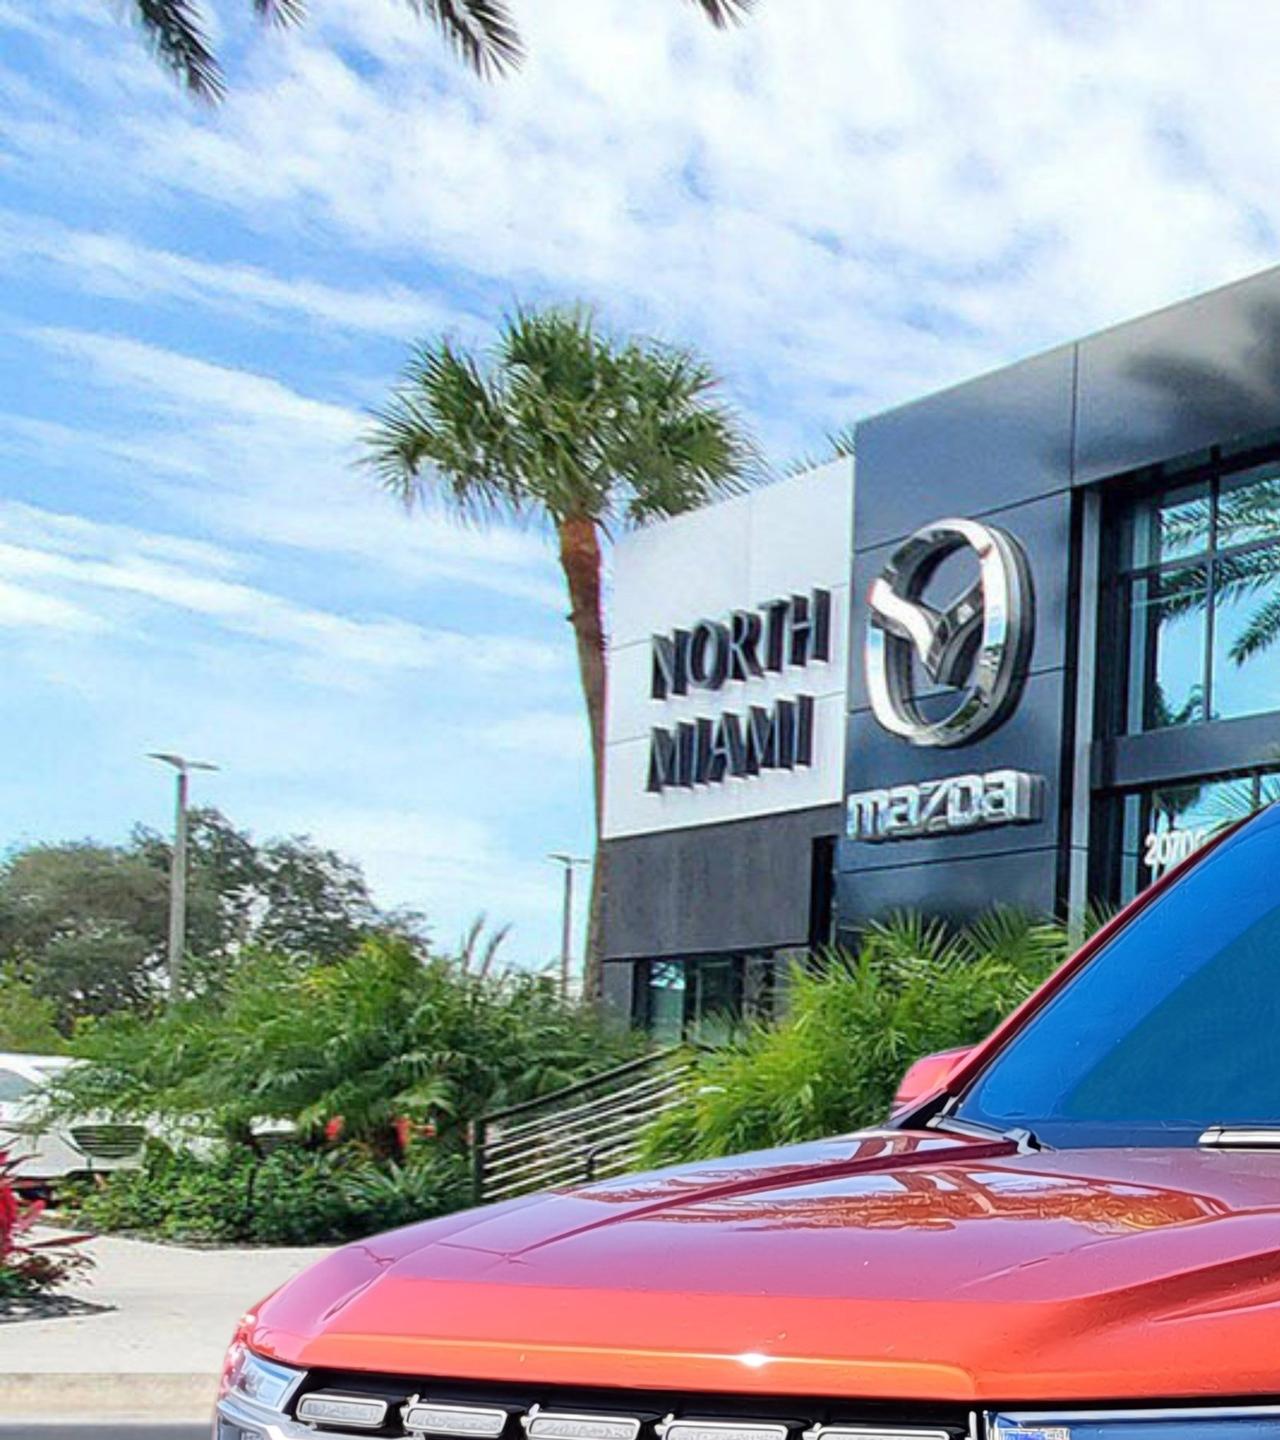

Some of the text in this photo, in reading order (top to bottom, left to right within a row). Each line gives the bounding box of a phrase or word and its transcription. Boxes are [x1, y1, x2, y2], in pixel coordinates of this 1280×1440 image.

[651, 588, 831, 700] NORTH
[646, 693, 815, 793] MIAMI
[846, 769, 1034, 841] mazda
